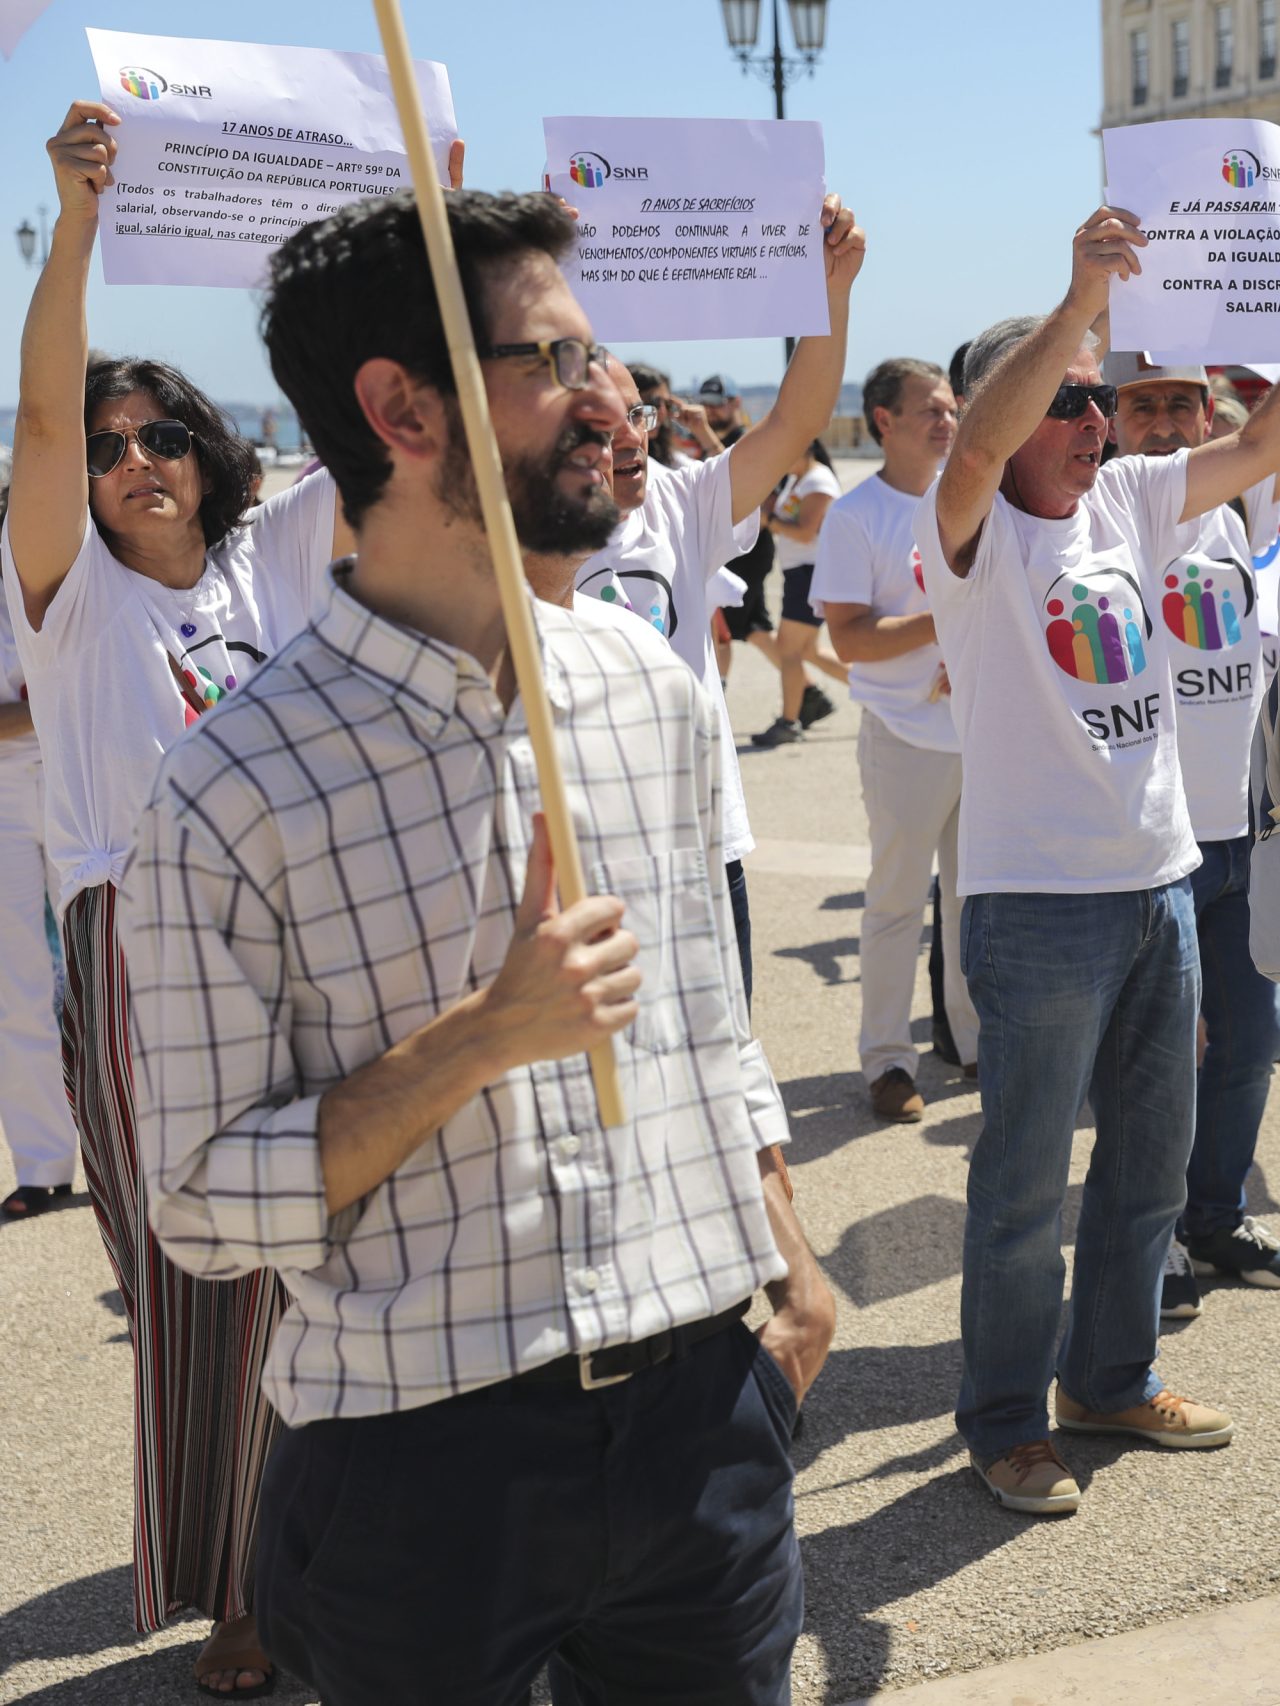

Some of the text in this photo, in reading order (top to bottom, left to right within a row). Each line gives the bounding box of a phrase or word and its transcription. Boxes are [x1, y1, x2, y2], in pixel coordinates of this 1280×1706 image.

[170, 83, 212, 97] SNR
[222, 121, 353, 146] 17 ANOS DE ATRASO...
[164, 142, 228, 160] PRINCÍPIO
[232, 150, 250, 162] DA
[254, 152, 324, 170] IGUALDADE
[386, 167, 400, 178] DA
[158, 161, 244, 180] CONSTITUIÇÃO
[247, 171, 262, 182] DA
[266, 174, 326, 189] REPÚBLICA
[613, 168, 648, 178] SNR
[117, 182, 154, 196] (Todos
[163, 188, 176, 197] os
[185, 189, 262, 206] trabalhadores
[272, 198, 293, 209] têm
[654, 198, 681, 210] ANOS
[682, 198, 697, 210] DE
[698, 196, 756, 210] SACRIFÍCIOS
[116, 203, 157, 215] salarial,
[162, 206, 244, 222] observando-se
[1170, 202, 1180, 212] E
[1183, 198, 1200, 212] JÁ
[1204, 201, 1276, 212] PASSARAM
[116, 222, 289, 244] igual, salário igual, nas categoria
[577, 224, 810, 238] NÃO PODEMOS CONTINUAR A VIVER DE
[1141, 229, 1195, 240] ONTRA
[1200, 229, 1210, 240] A
[1214, 227, 1280, 242] VIOLAÇÃO
[579, 243, 808, 260] VENCIMENTOS/COMPONENTES VIRTUAIS E FICTÍCIAS,
[1208, 252, 1226, 262] DA
[582, 270, 600, 282] MAS
[602, 270, 618, 282] SIM
[621, 269, 635, 282] DO
[638, 269, 660, 282] QUE
[662, 266, 669, 280] É
[672, 268, 734, 280] EFETIVAMENTE
[736, 268, 756, 280] REAL
[1163, 279, 1222, 290] CONTRA
[1228, 280, 1238, 290] A
[1176, 662, 1252, 697] SNR
[1116, 740, 1142, 749] Nacional
[1143, 736, 1152, 744] dos
